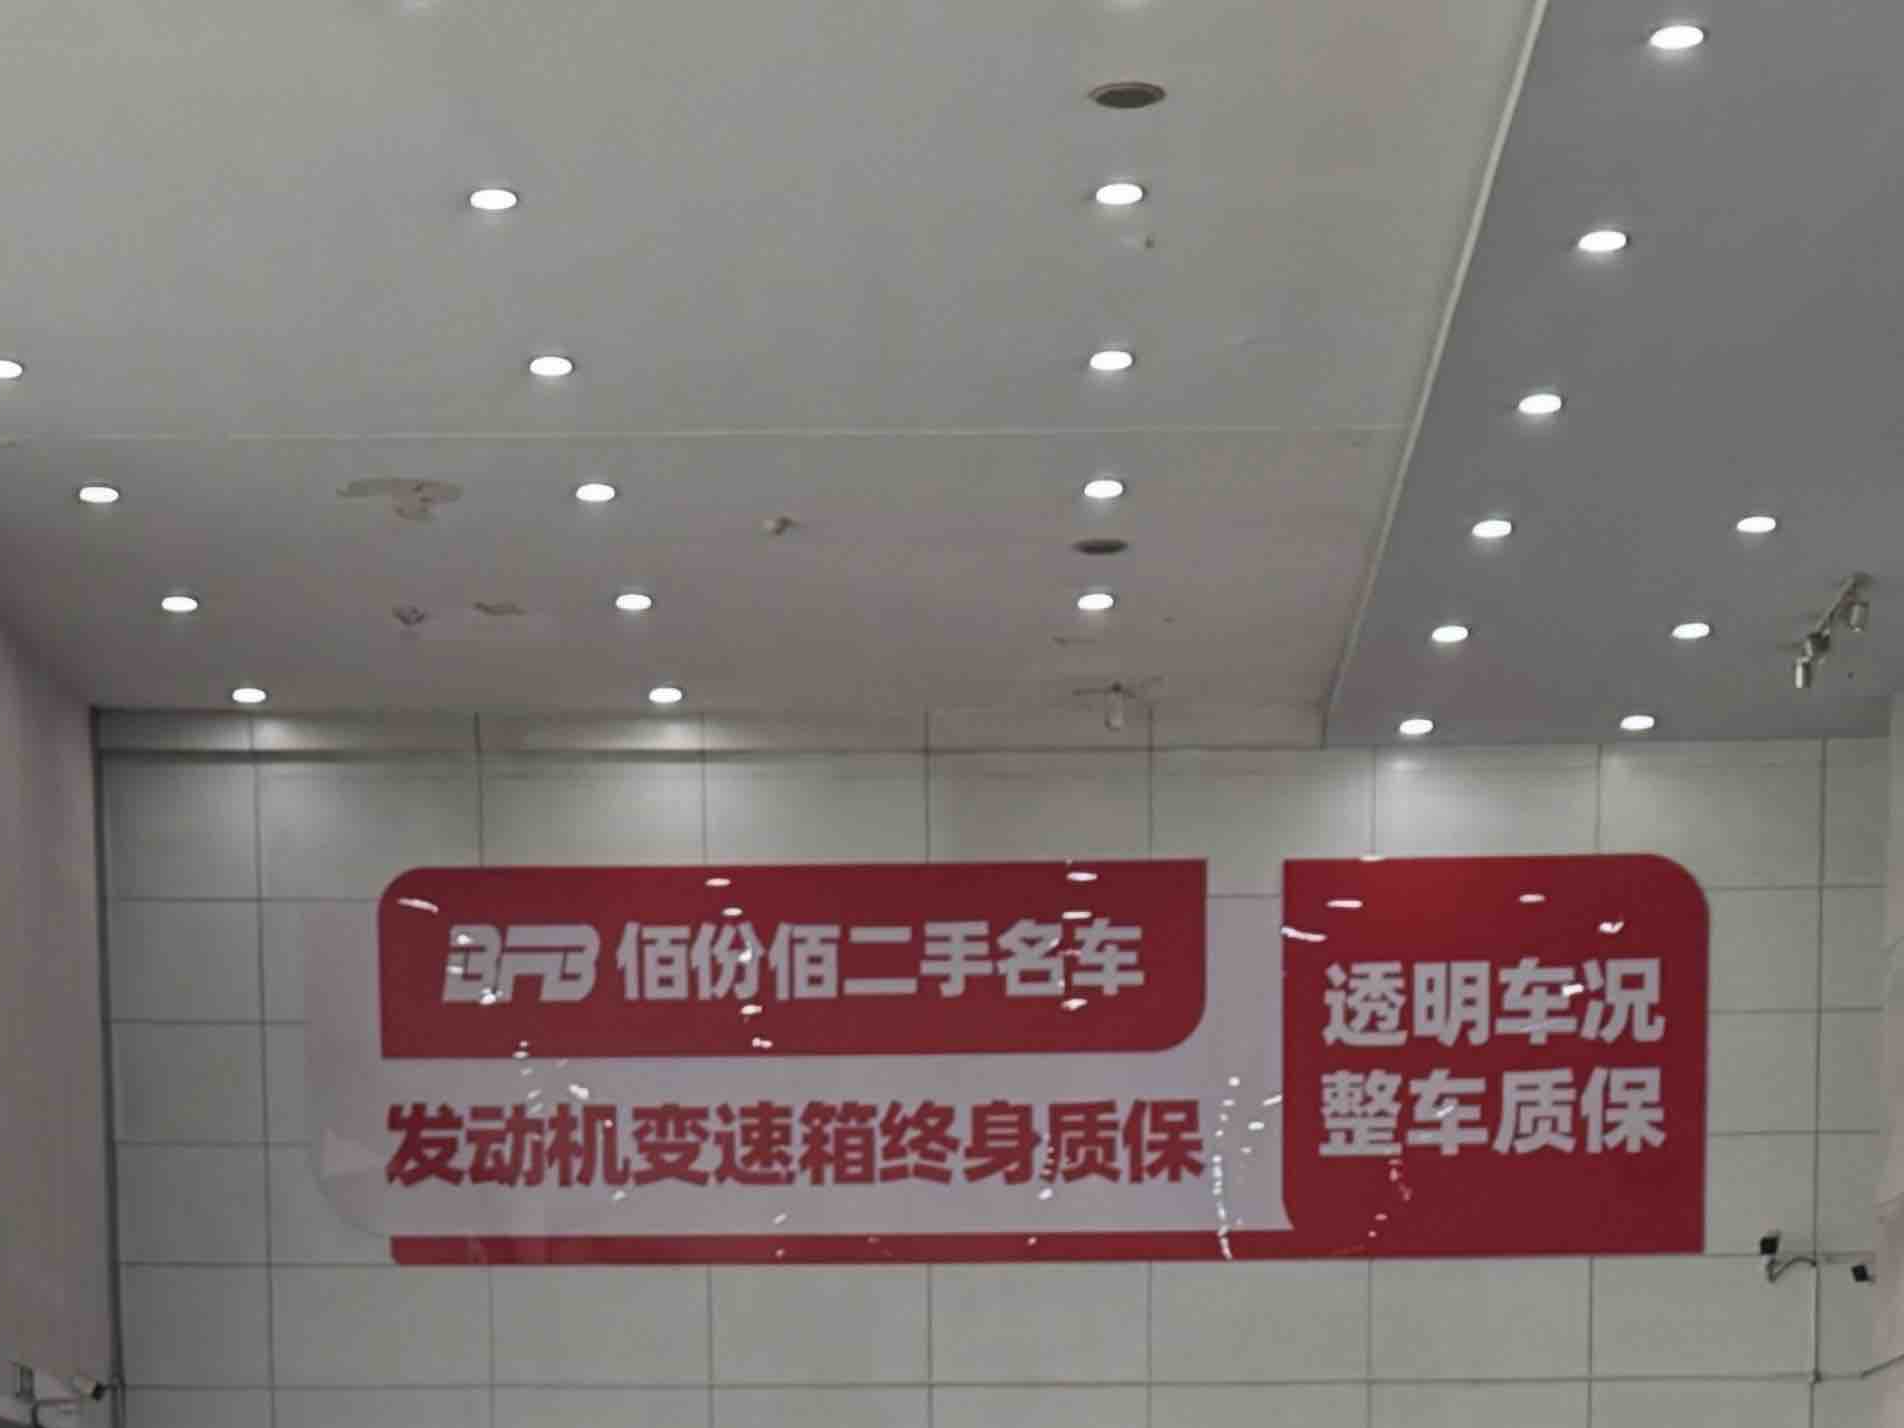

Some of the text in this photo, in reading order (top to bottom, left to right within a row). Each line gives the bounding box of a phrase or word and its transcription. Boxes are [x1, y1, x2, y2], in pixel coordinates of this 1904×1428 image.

[616, 918, 1144, 1001] 佰份佰二手名车
[1322, 957, 1665, 1046] 透明车况
[385, 1100, 1205, 1188] 发动机变速箱终身质保
[1318, 1066, 1666, 1157] 整车质保
